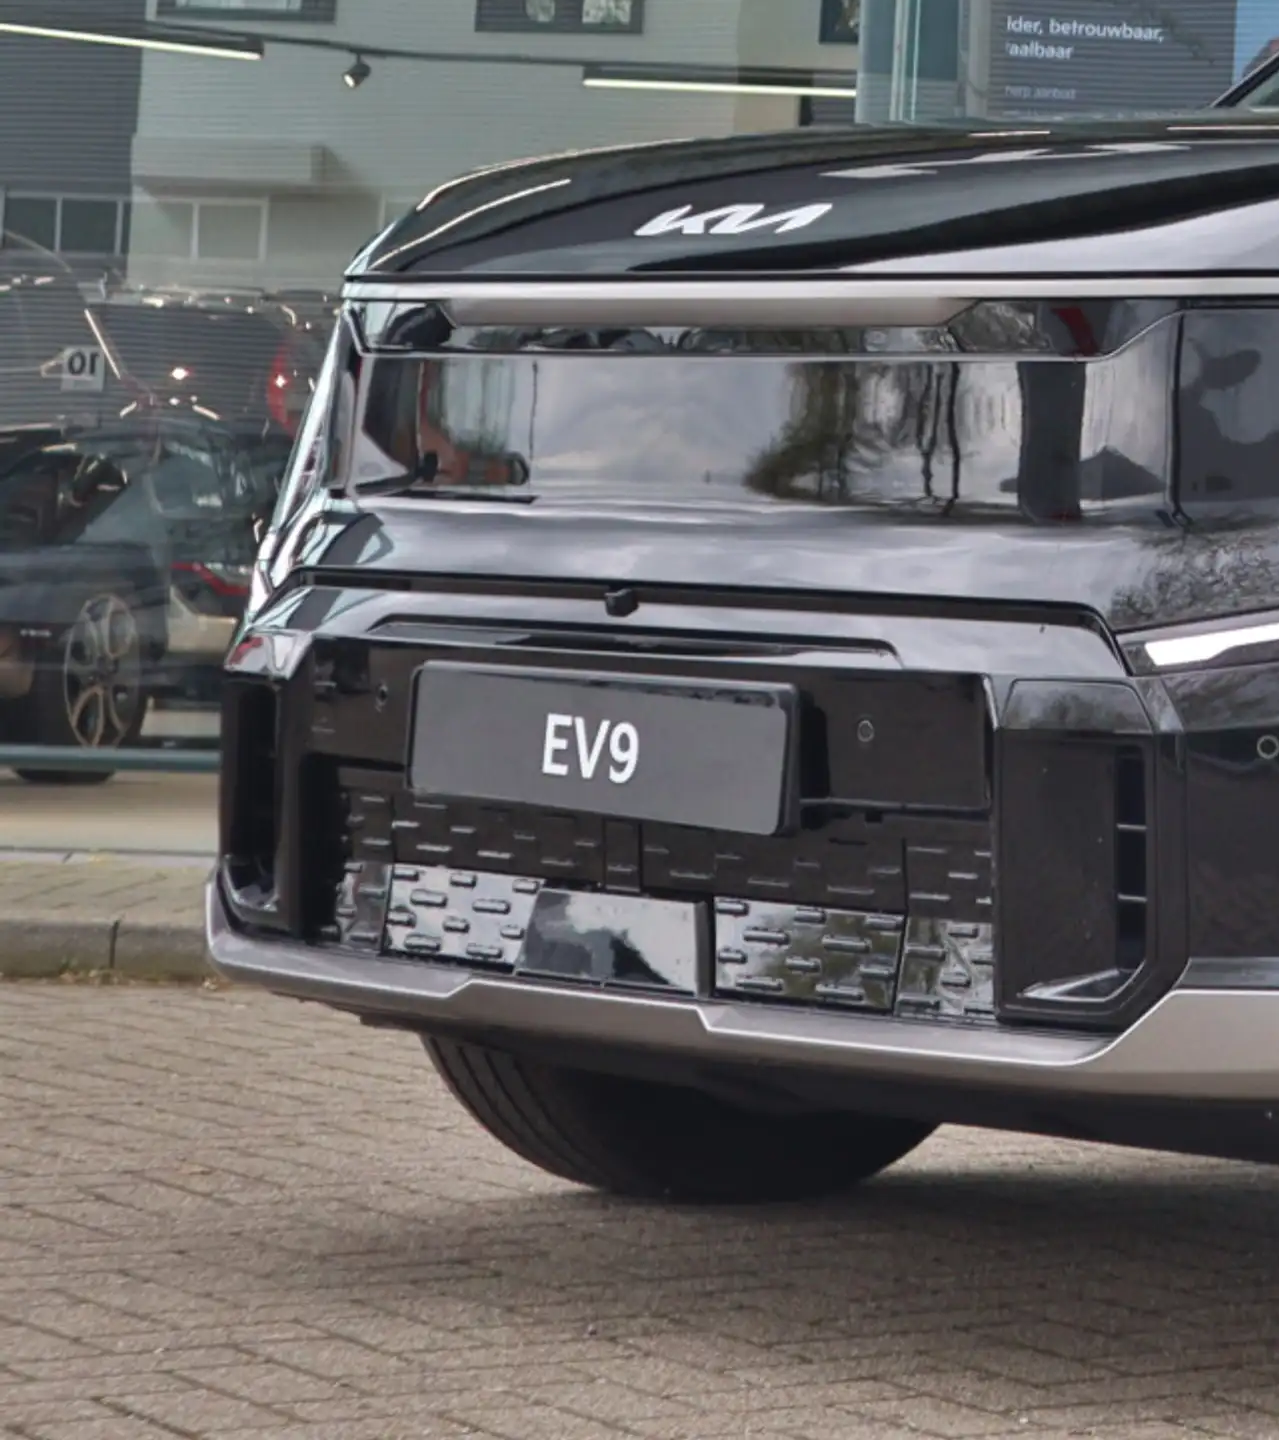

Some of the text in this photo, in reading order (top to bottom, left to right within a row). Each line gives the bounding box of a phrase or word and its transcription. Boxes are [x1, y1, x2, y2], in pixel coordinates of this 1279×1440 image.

[1049, 17, 1165, 43] betrouwbaar,
[634, 203, 833, 236] KIA
[542, 712, 640, 784] EV9
